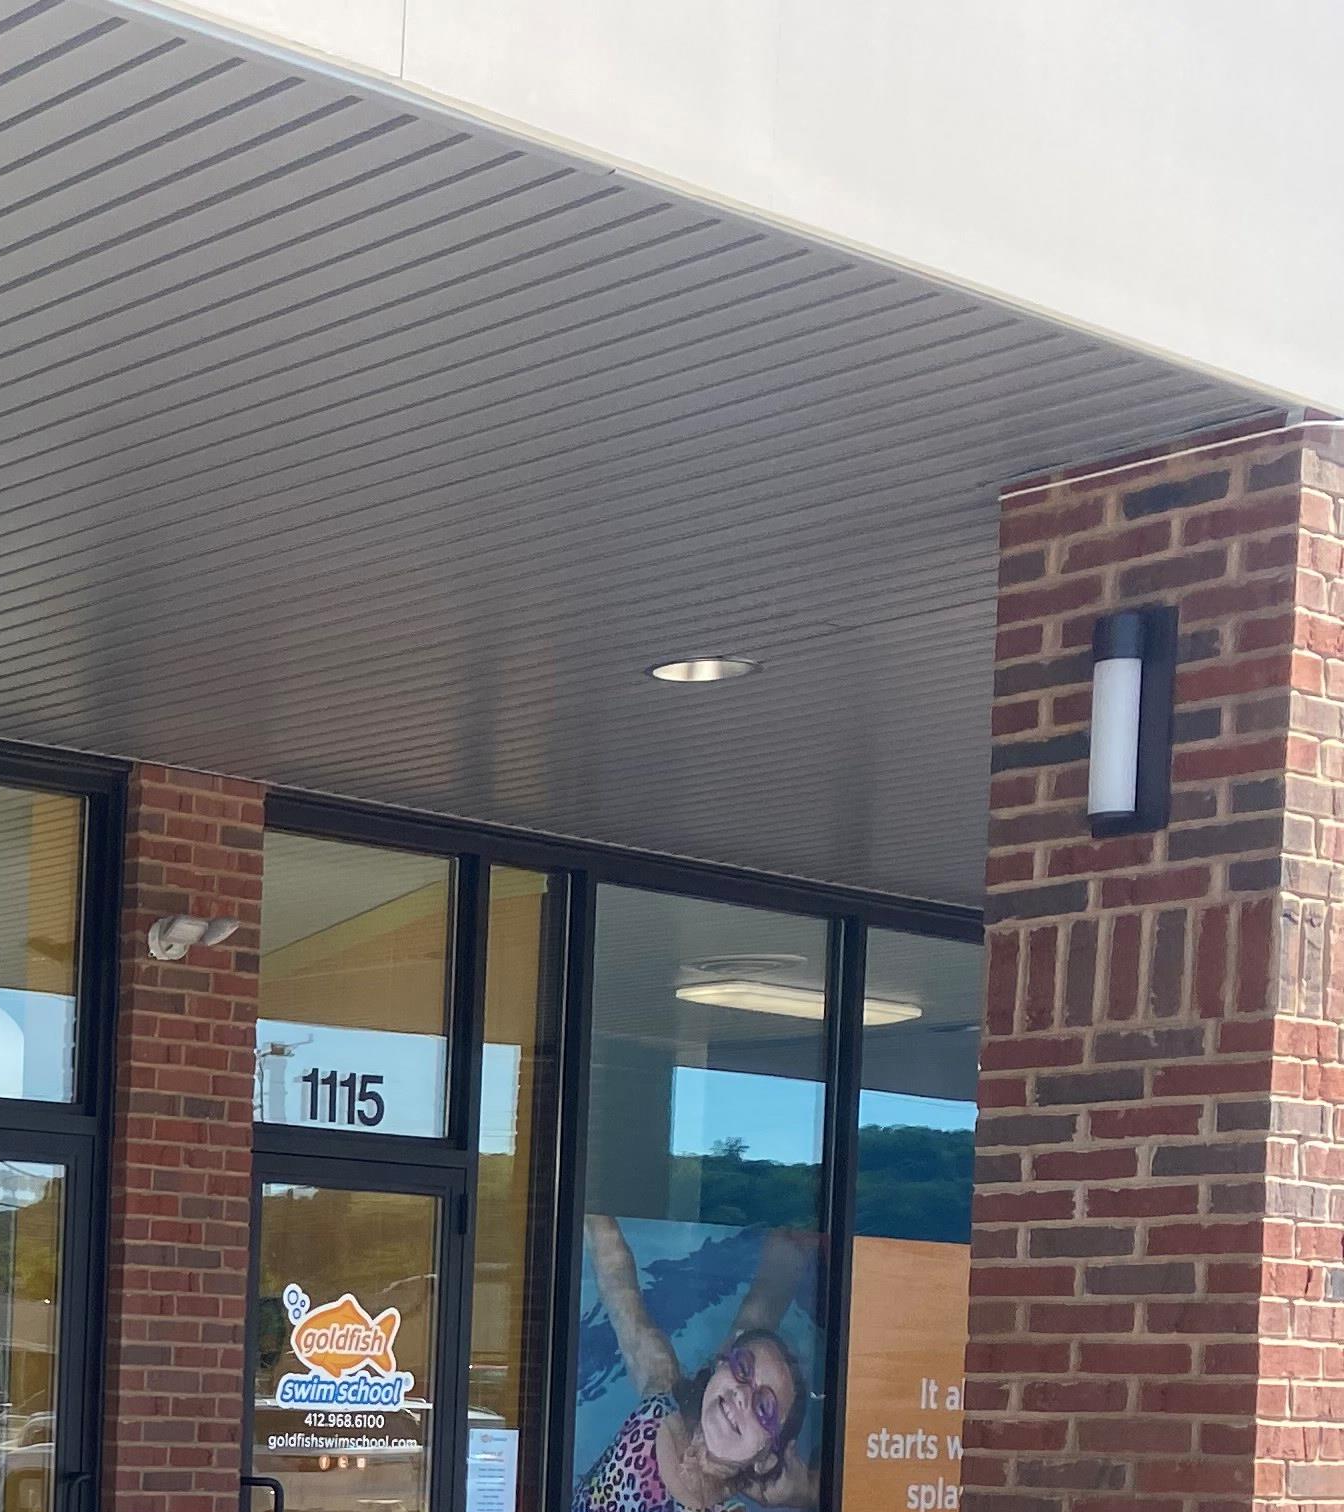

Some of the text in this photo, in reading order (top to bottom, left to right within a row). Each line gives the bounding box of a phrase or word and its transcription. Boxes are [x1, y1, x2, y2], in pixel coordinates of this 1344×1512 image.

[302, 1067, 384, 1127] 1115
[302, 1326, 385, 1354] goldfish
[281, 1375, 403, 1406] swim school
[920, 1377, 938, 1410] It
[304, 1412, 385, 1429] 412.968.6100
[268, 1432, 418, 1450] goldfishswimschool.com
[866, 1427, 938, 1459] starts
